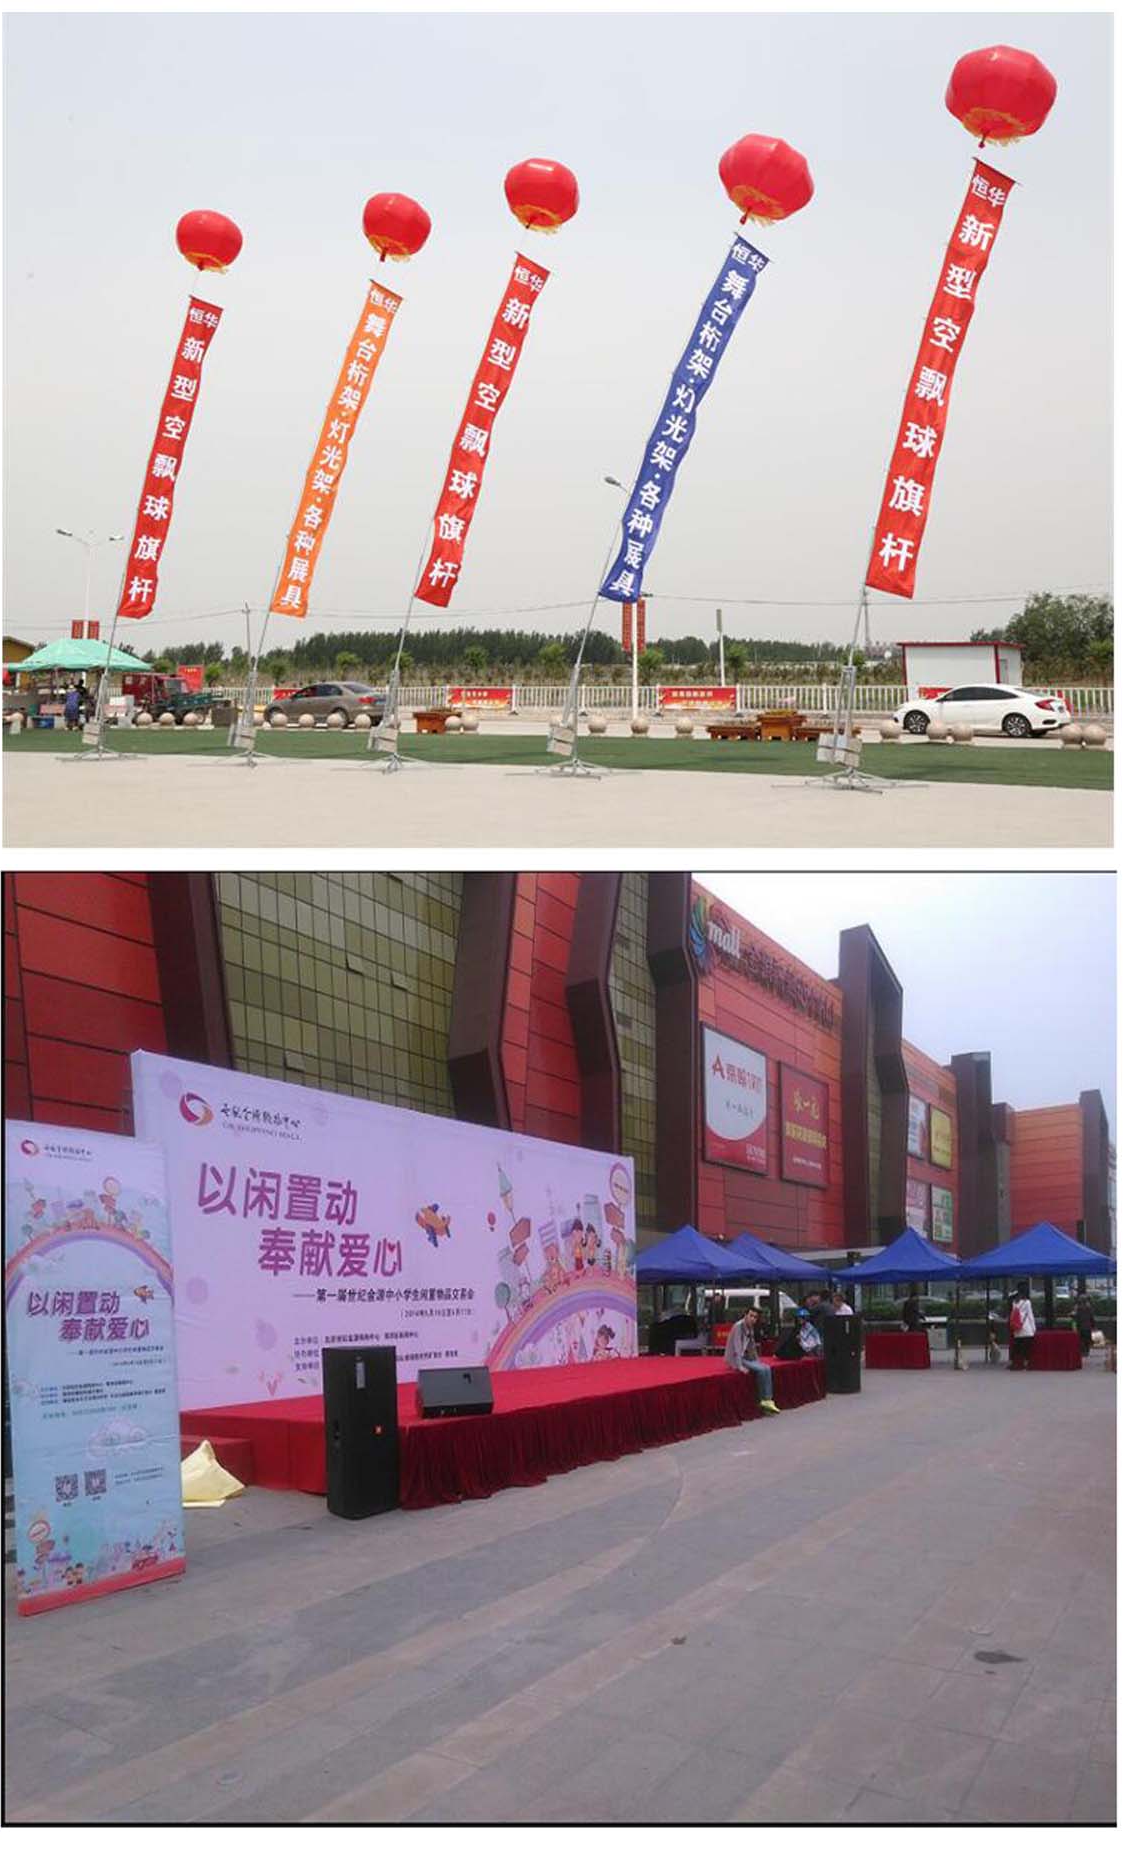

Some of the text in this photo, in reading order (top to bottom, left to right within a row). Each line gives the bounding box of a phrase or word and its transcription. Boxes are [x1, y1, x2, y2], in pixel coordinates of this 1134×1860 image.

[971, 174, 1006, 208] 恒华
[730, 243, 766, 273] 恒华
[513, 265, 544, 293] 恒华
[188, 307, 218, 328] 恒华
[879, 214, 994, 571] 新型空飘球旗杆
[428, 298, 531, 587] 新型空飘球旗杆
[128, 337, 205, 603] 新型空飘球旗杆
[197, 1162, 359, 1227] 以闲置动
[257, 1228, 403, 1279] 奉献爱心
[26, 1290, 121, 1317] 以闲置动
[58, 1318, 150, 1342] 奉献爱心
